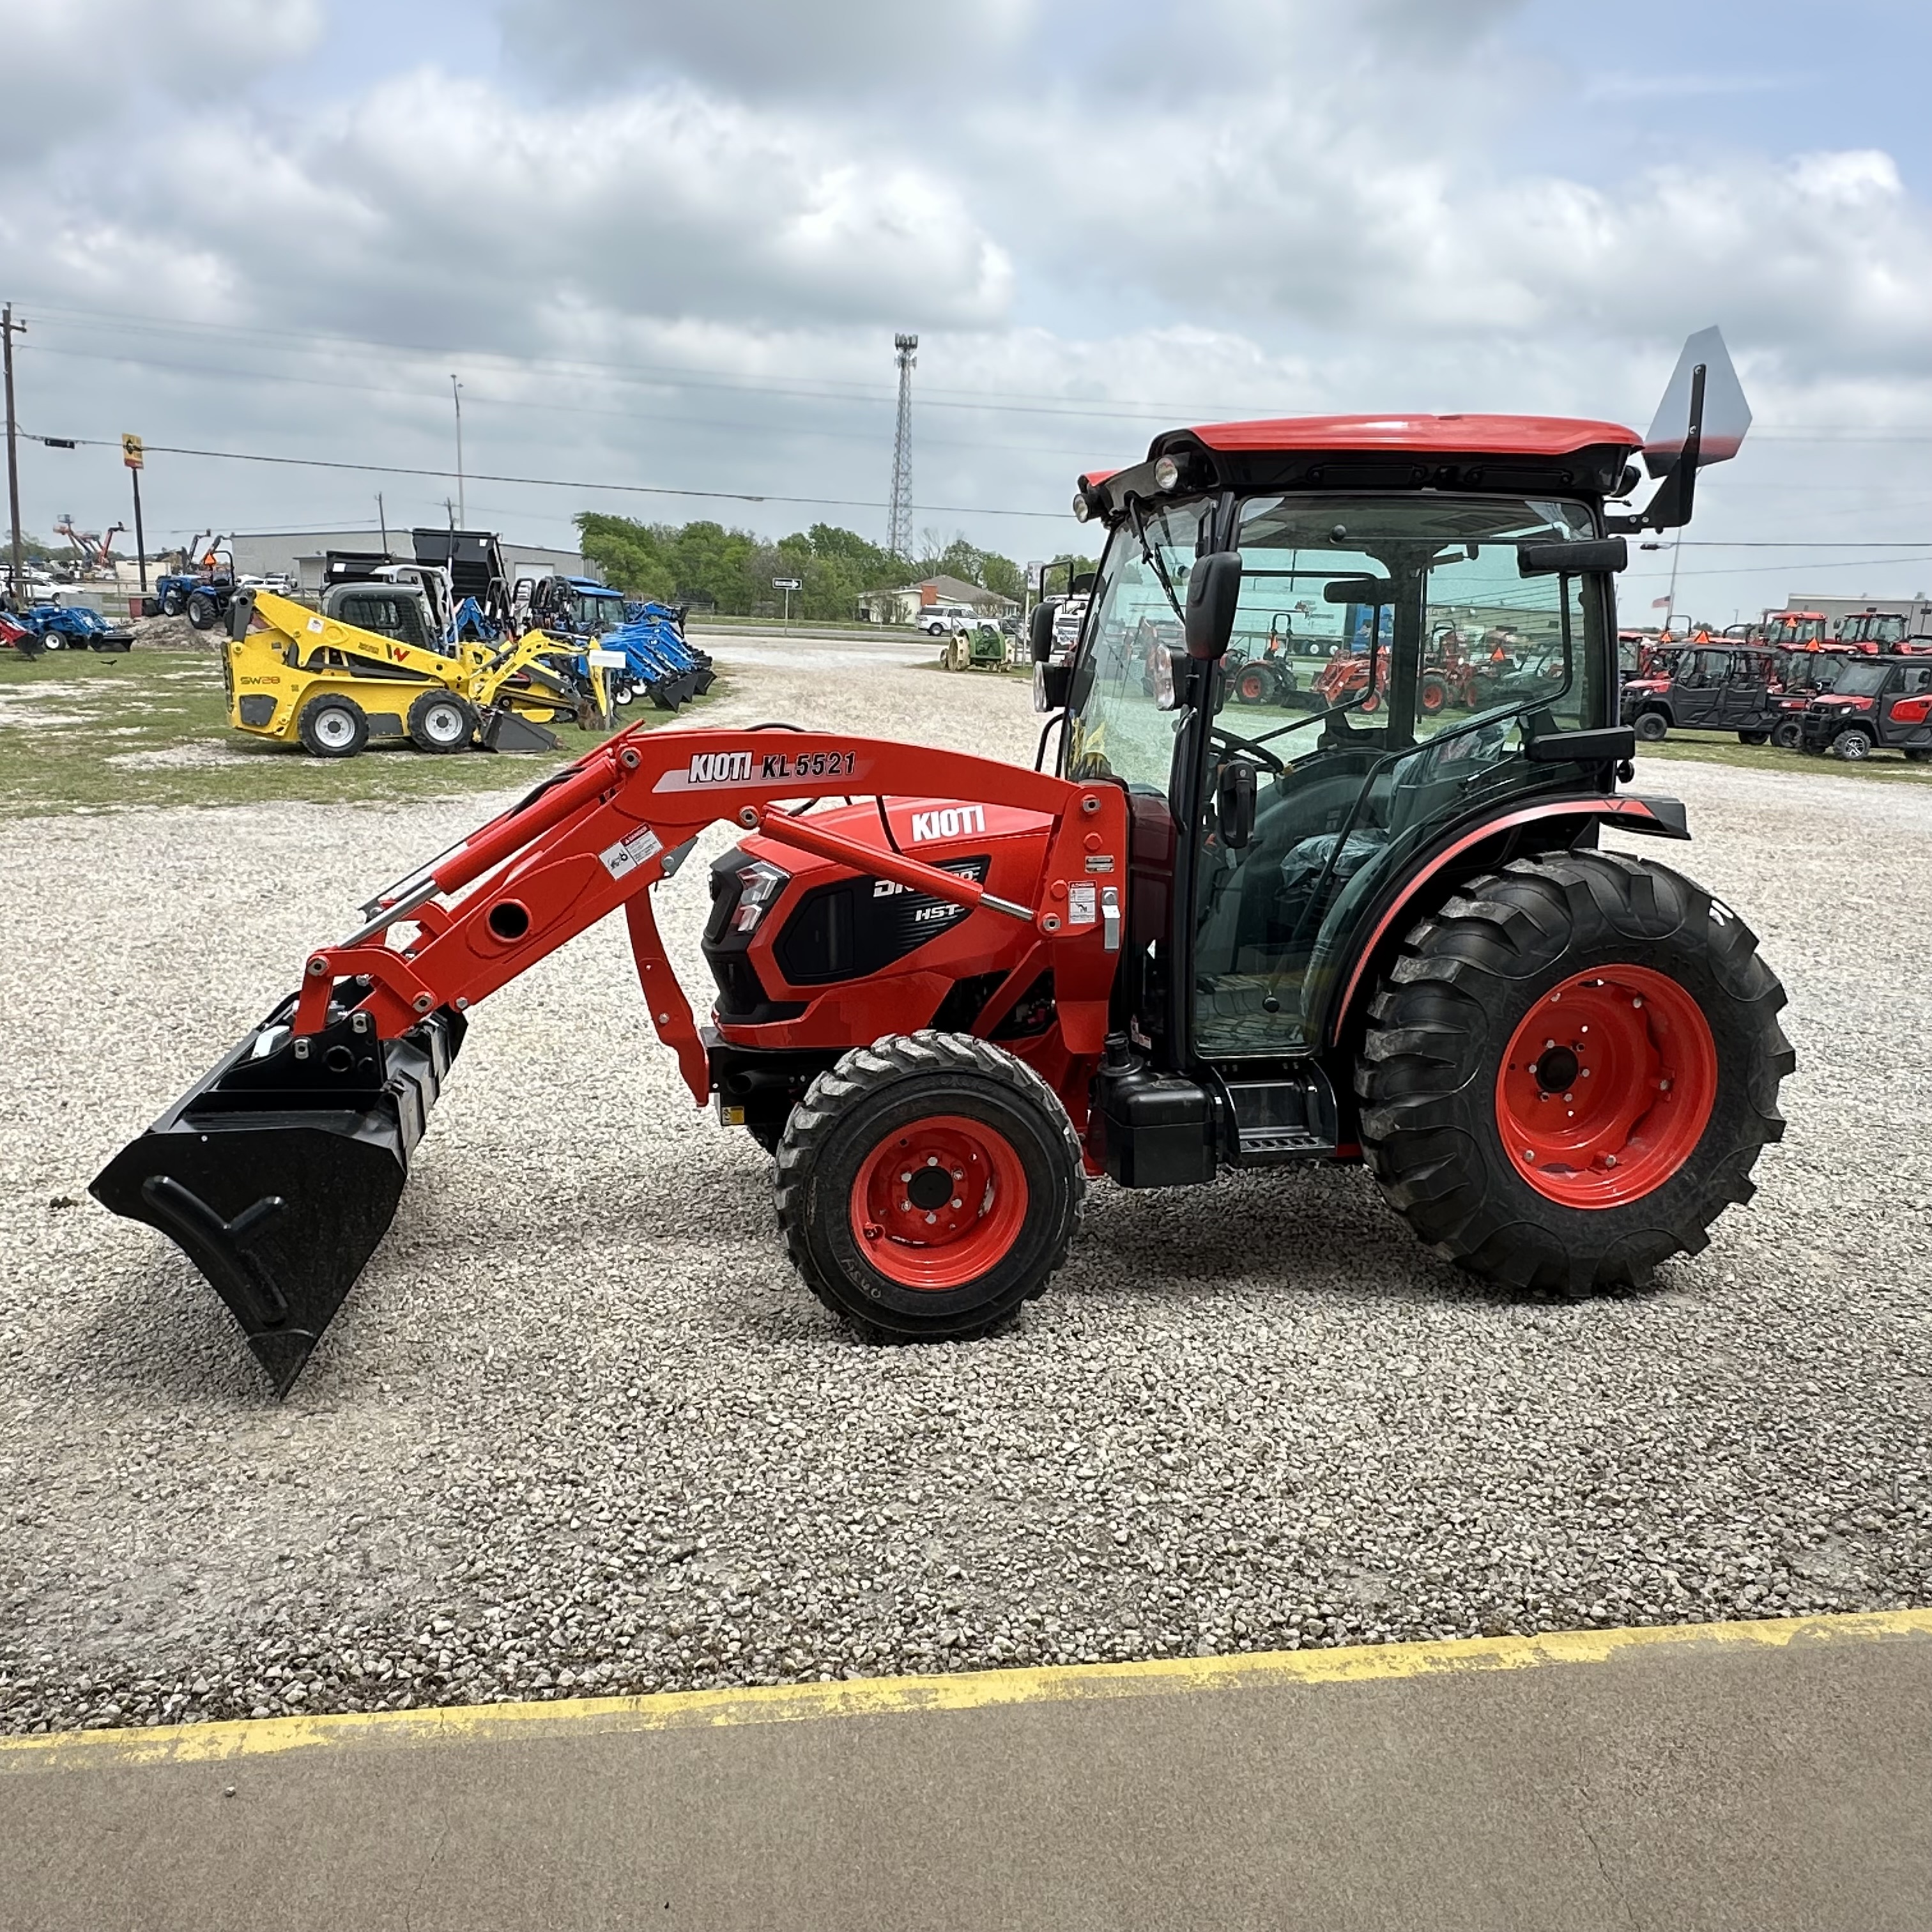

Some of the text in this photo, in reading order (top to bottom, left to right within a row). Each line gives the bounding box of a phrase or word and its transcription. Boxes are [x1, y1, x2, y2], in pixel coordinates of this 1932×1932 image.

[240, 676, 280, 685] SW28
[688, 751, 755, 783] KIOTI
[912, 805, 985, 841] KIOTI
[915, 903, 961, 921] HST
